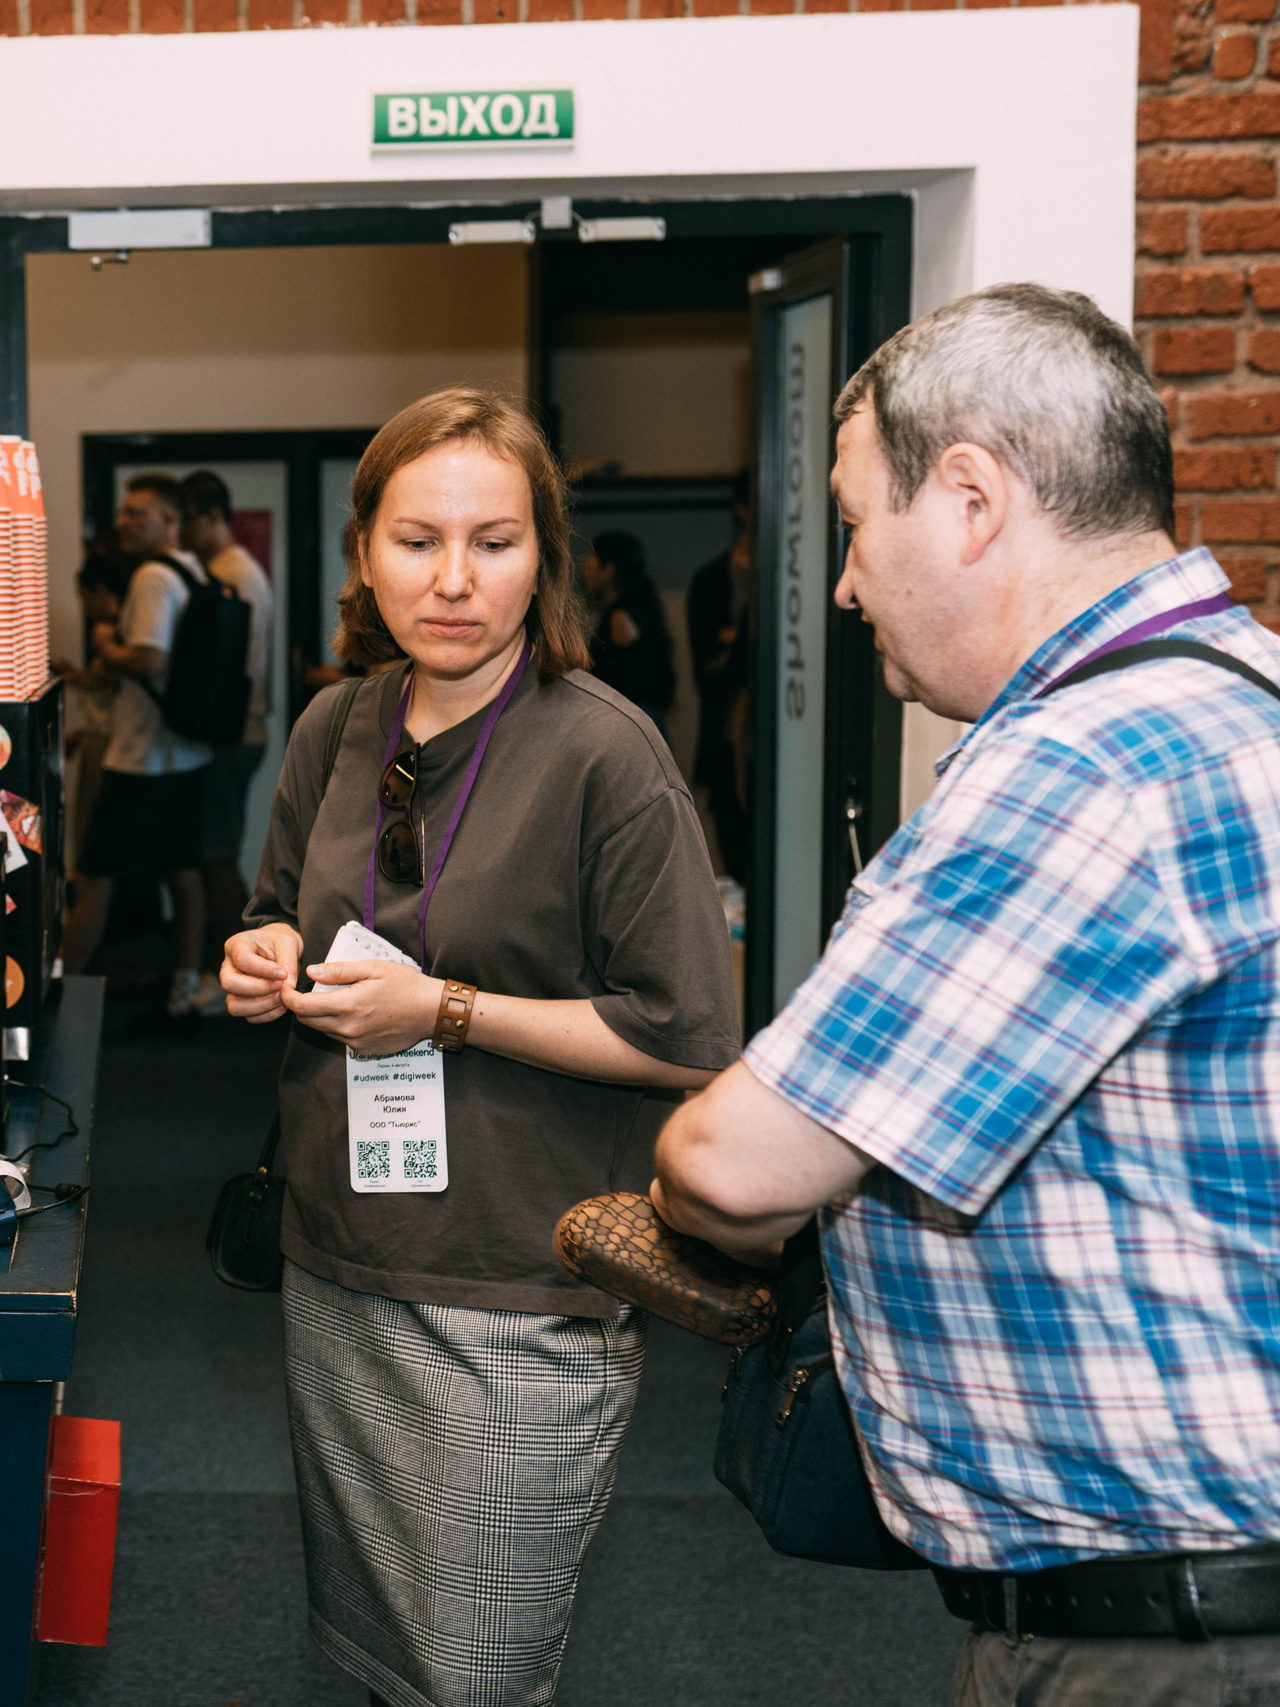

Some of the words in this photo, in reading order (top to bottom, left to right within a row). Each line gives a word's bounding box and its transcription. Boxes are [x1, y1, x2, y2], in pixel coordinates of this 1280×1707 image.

[387, 94, 560, 137] ВЫХОД
[353, 1074, 389, 1082] #udweek
[392, 1072, 437, 1082] #digiweek
[374, 1094, 415, 1103] Абрамова
[383, 1105, 407, 1113] Юлия
